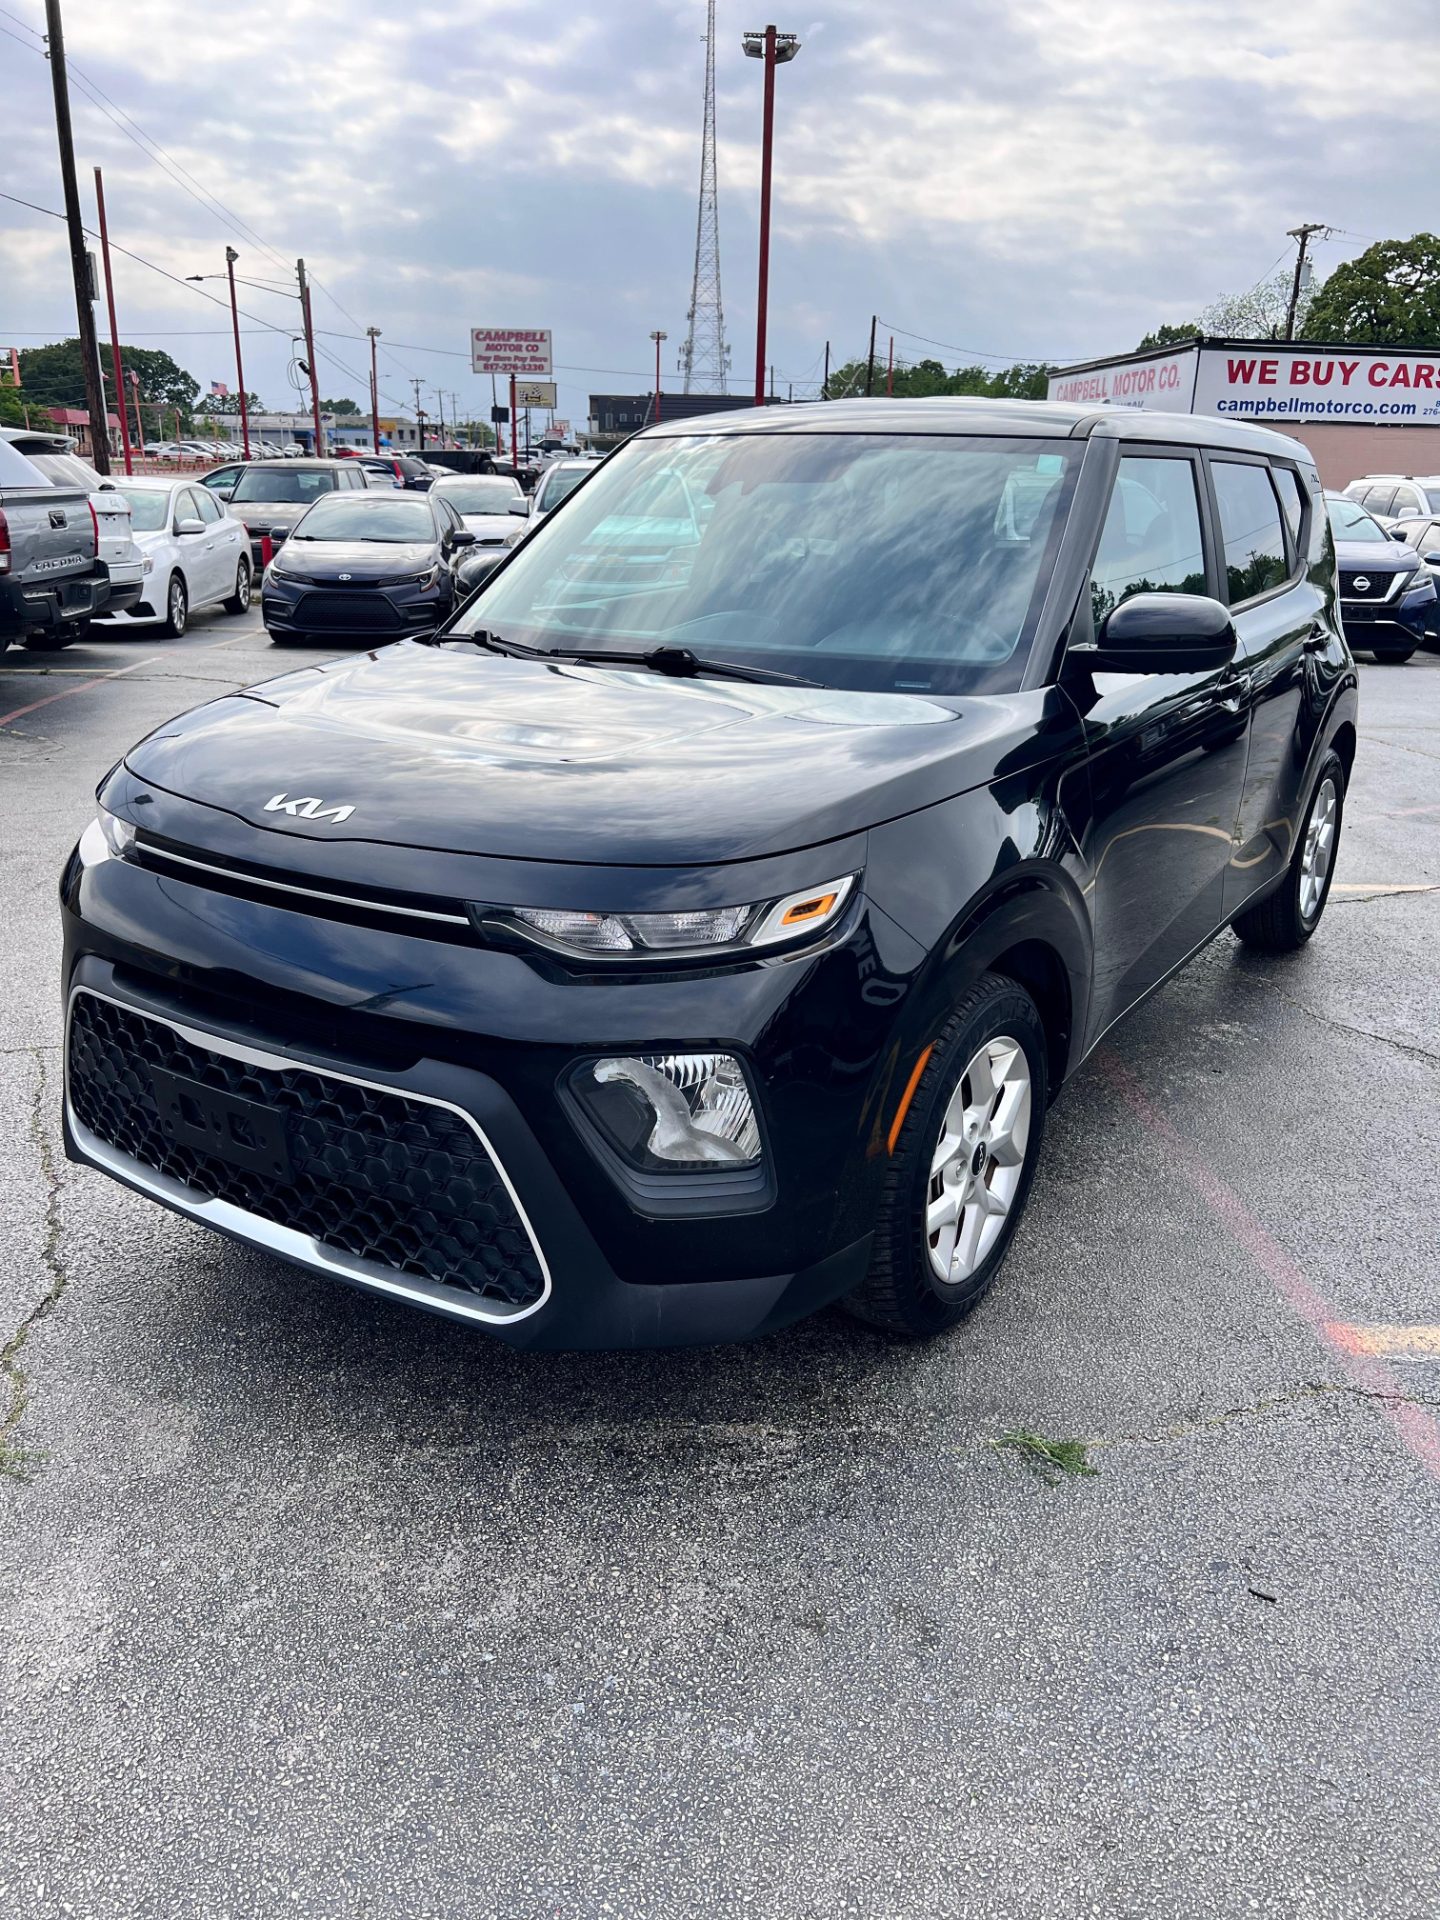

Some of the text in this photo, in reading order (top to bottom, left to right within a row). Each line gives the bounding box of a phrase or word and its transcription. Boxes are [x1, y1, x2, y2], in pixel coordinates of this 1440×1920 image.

[475, 331, 547, 342] CAMPBELL
[485, 343, 539, 352] MOTOR CO
[1056, 364, 1180, 401] CAMPBELL MOTOR CO.
[1227, 359, 1440, 390] WE BUY CAR
[1217, 397, 1416, 415] campbellmotorco.com
[32, 556, 82, 572] TACOMA
[263, 792, 357, 825] KIA
